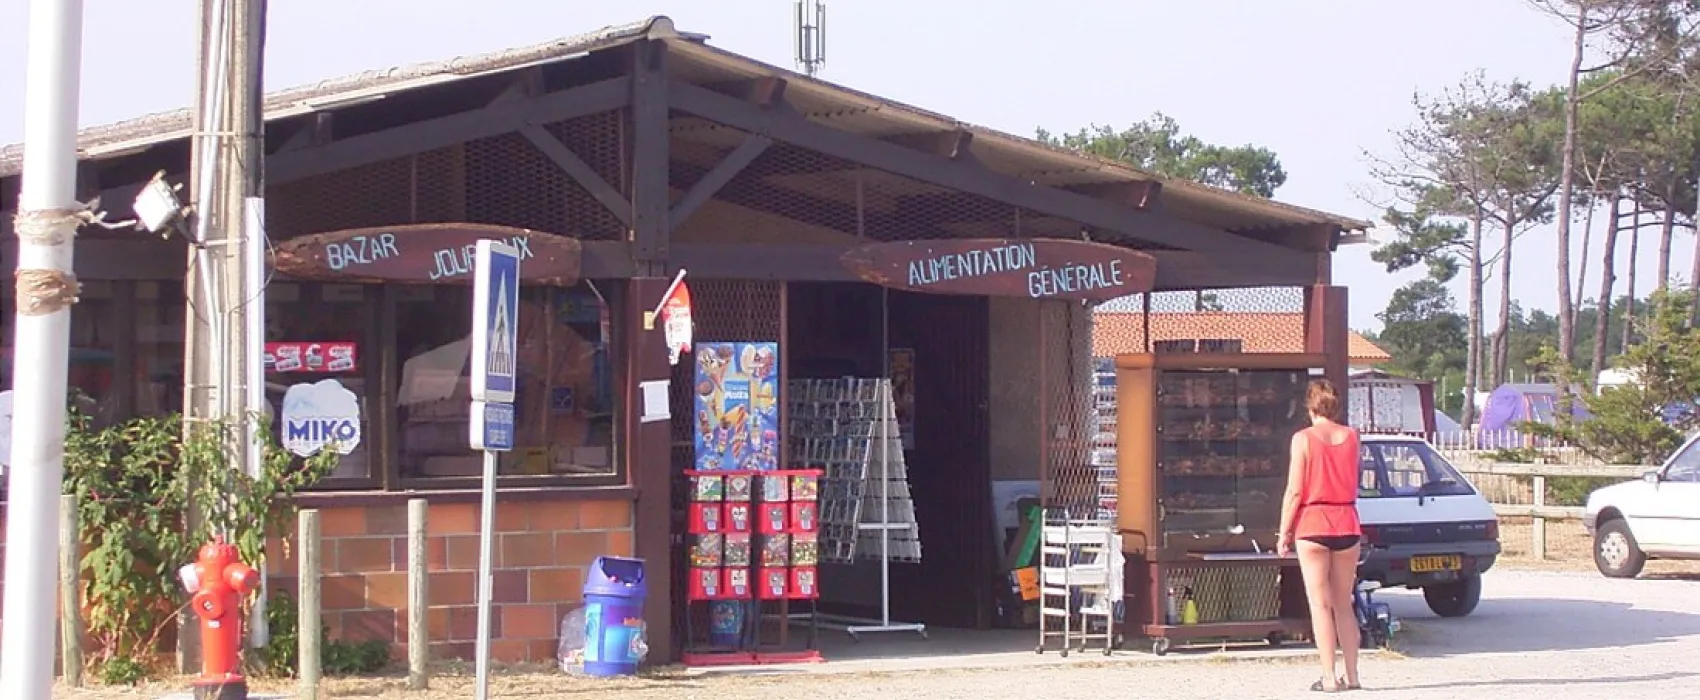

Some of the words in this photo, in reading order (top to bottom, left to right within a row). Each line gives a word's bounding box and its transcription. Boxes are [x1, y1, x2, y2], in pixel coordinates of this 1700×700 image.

[326, 233, 400, 270] BAZAR
[428, 235, 534, 280] JOURX
[908, 243, 1036, 286] ALIMENTATION
[1027, 259, 1125, 298] GÉNÉRALE
[288, 420, 356, 441] MIKO
